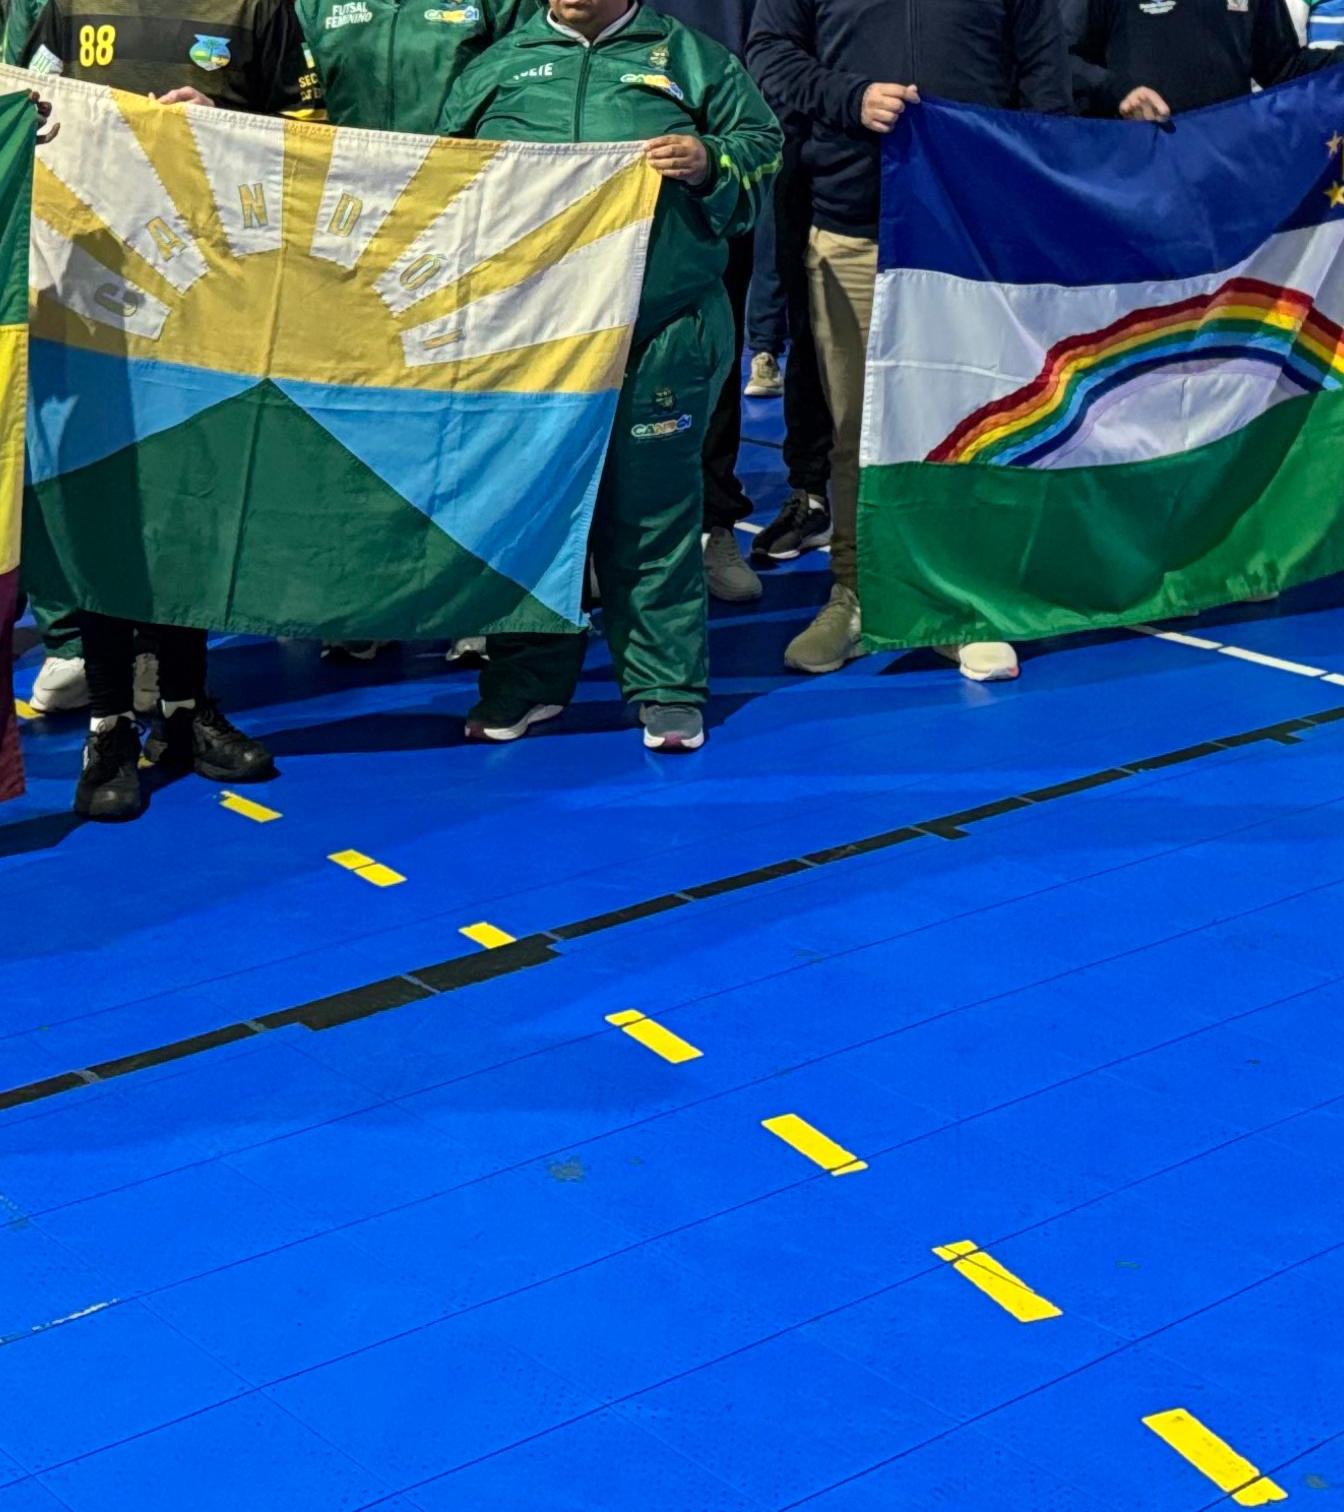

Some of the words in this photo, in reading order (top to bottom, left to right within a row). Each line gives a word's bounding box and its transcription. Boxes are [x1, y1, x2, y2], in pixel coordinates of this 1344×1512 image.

[325, 11, 373, 29] FEMININO
[332, 1, 368, 16] FUTSAL
[79, 24, 116, 68] 88
[94, 182, 464, 350] CANDÓI
